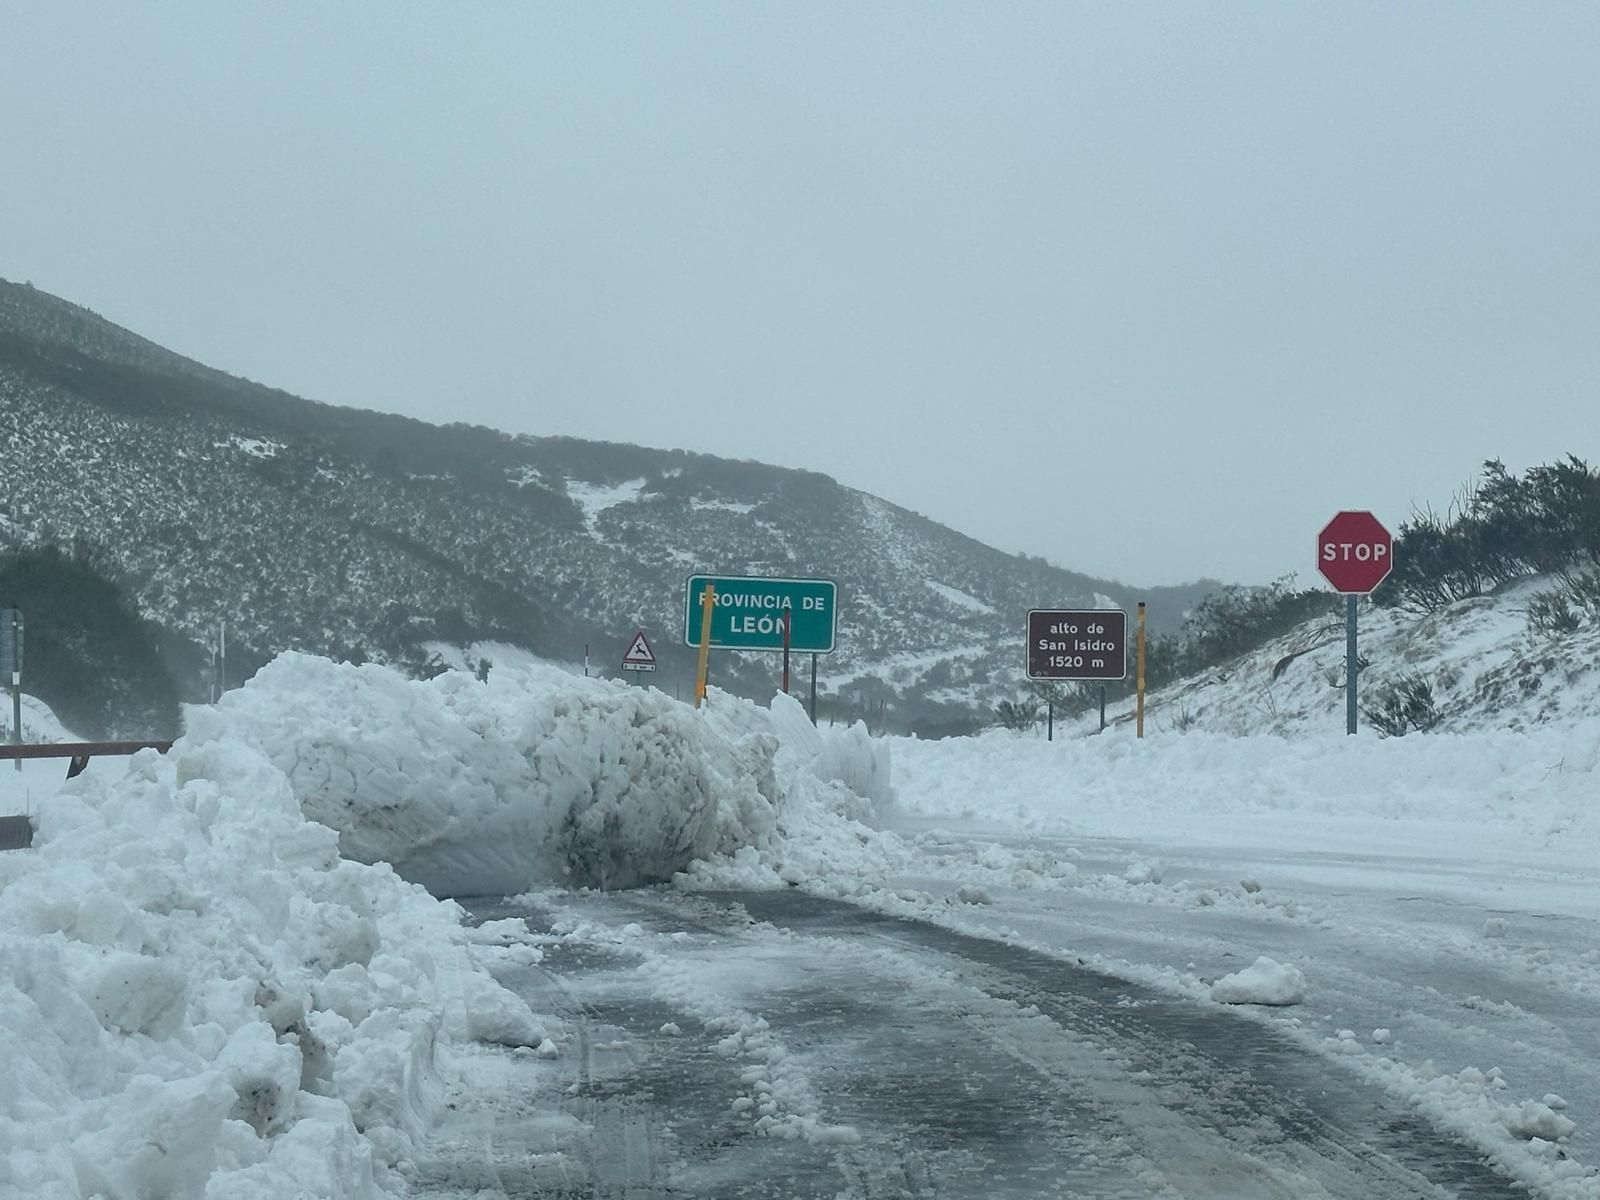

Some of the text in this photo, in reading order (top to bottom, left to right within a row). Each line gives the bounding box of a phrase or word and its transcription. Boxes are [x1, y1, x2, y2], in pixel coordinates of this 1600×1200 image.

[1323, 543, 1387, 561] STOP
[802, 597, 825, 610] DE
[731, 614, 791, 634] LEÓN
[1050, 622, 1104, 634] alto de
[1039, 639, 1115, 651] San Isidro
[1049, 656, 1104, 667] 1520 m
